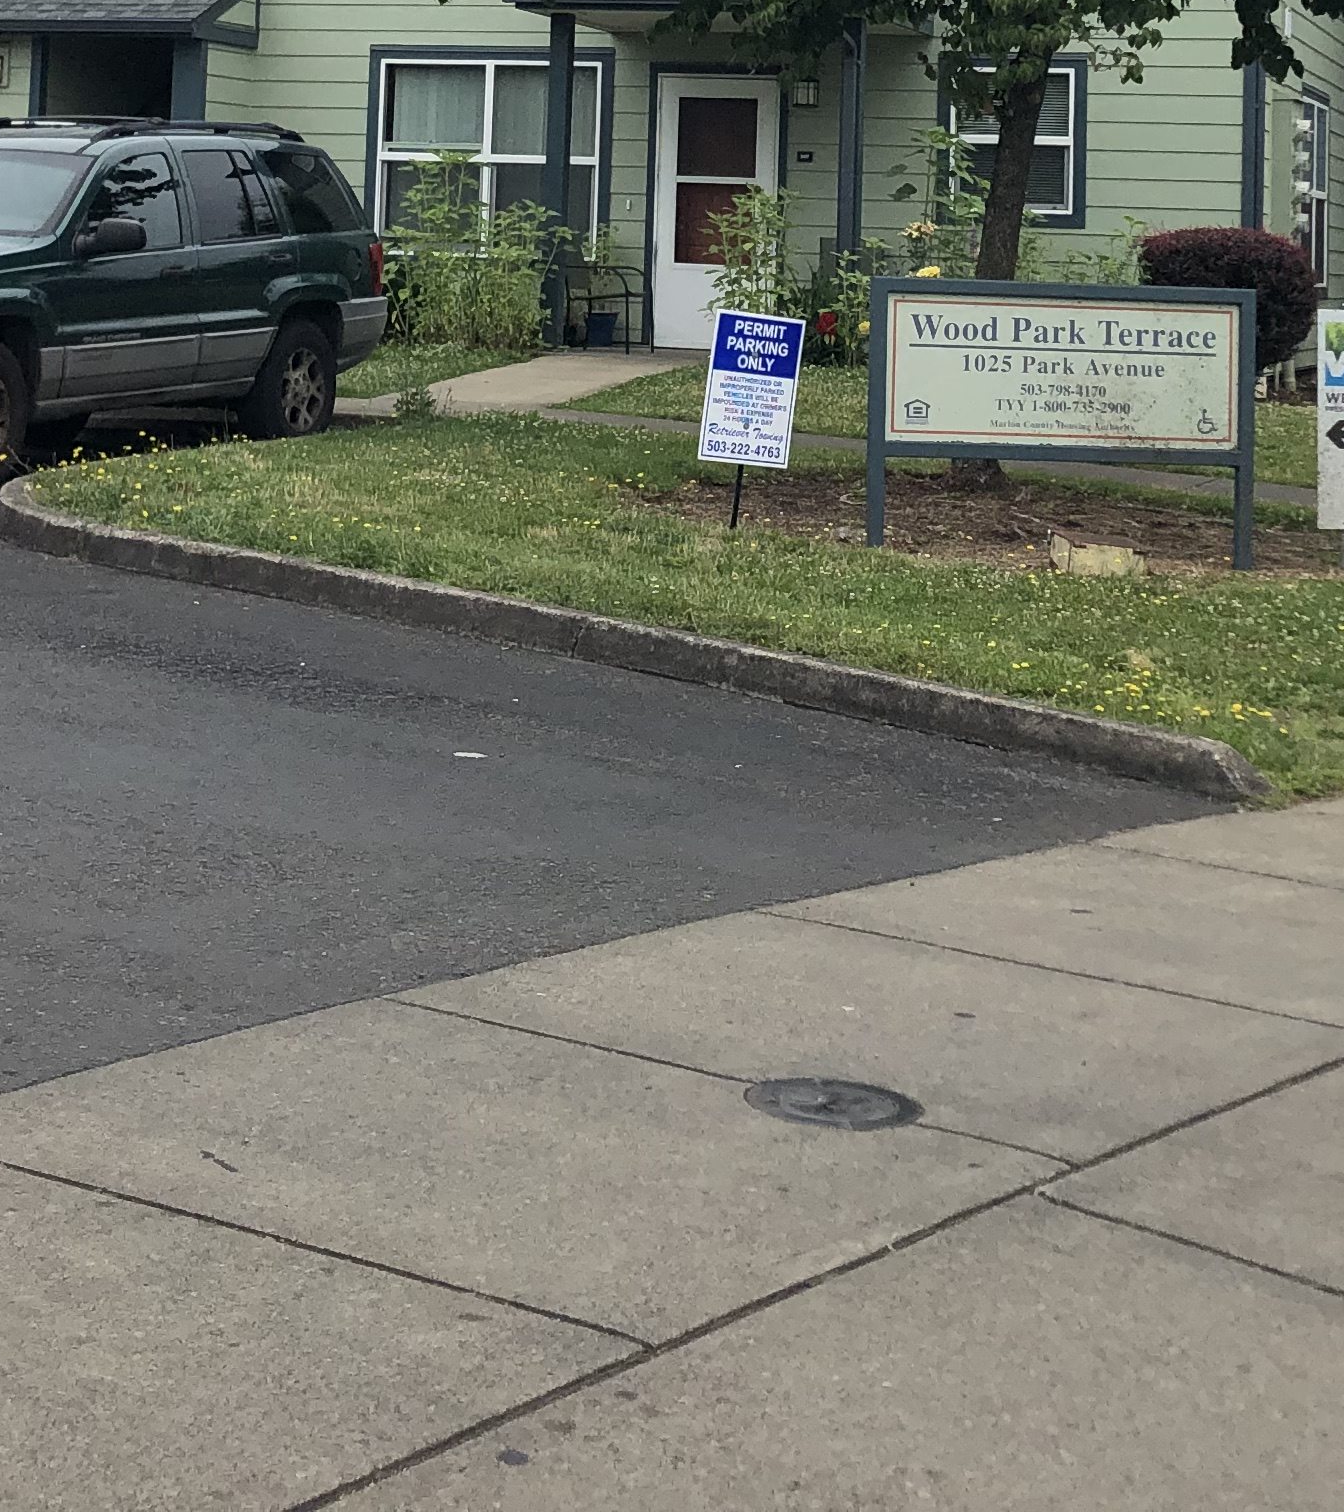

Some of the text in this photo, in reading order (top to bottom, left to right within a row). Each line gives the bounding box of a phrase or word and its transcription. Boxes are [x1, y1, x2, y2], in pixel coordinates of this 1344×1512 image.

[734, 320, 787, 339] PERMIT
[911, 314, 1216, 349] Wood Park Terrace
[726, 336, 789, 357] PARKING
[737, 354, 775, 372] ONLY
[962, 353, 1165, 378] 1025 Park Avenue
[1020, 384, 1107, 398] 503-798-4170
[995, 399, 1131, 415] TYY 1-800-735-2900
[708, 423, 783, 445] Retriever Towing
[707, 440, 781, 458] 503-222-4763
